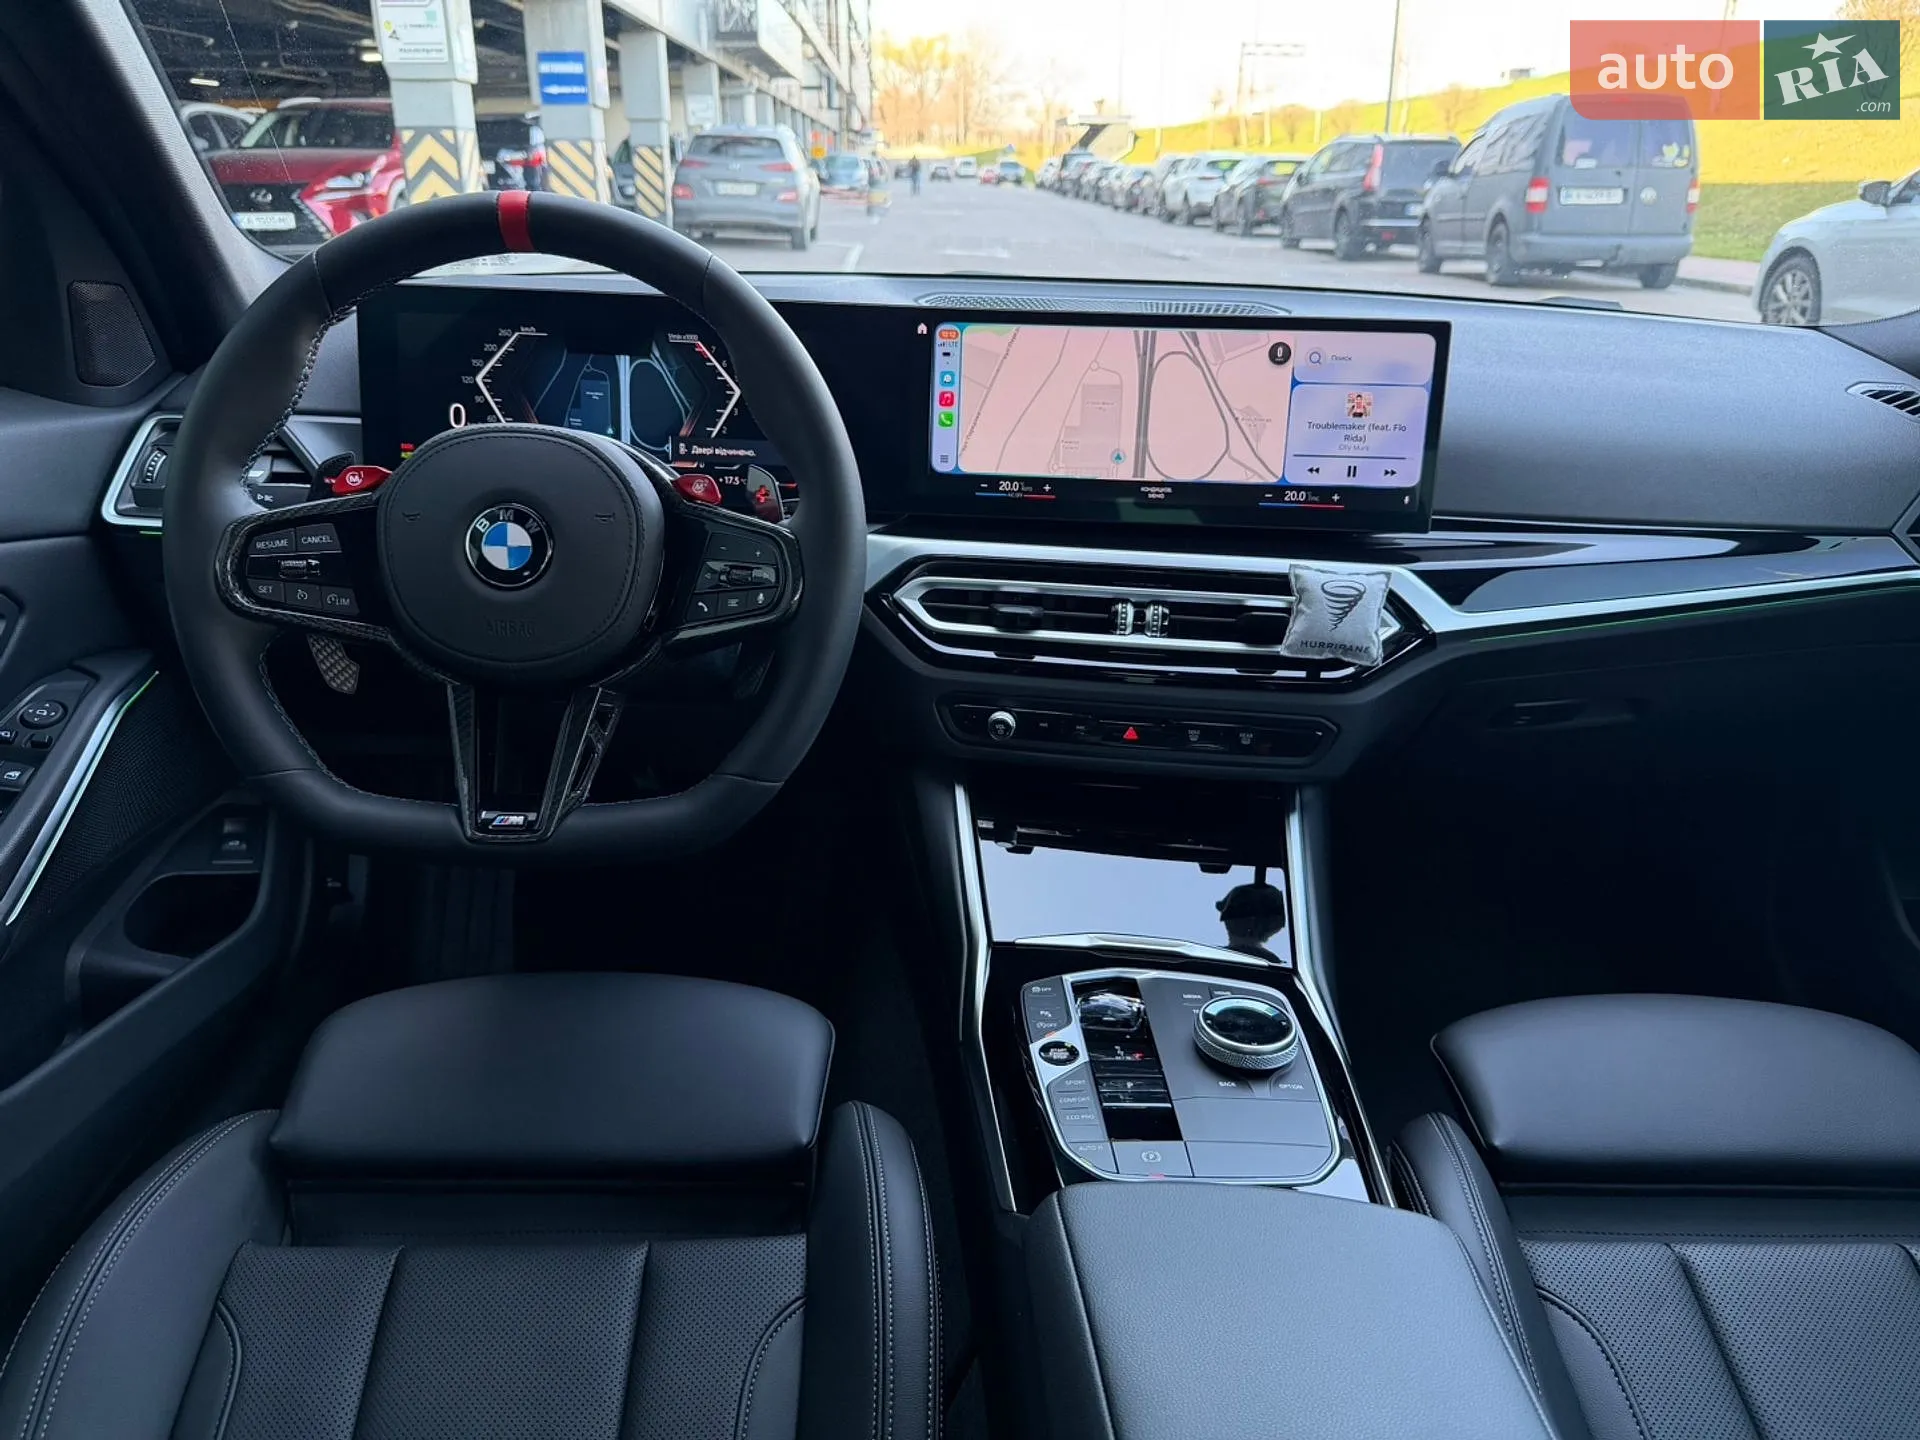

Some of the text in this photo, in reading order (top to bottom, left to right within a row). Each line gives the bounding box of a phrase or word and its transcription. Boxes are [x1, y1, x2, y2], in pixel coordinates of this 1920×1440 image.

[461, 375, 475, 383] 120
[449, 403, 466, 428] 0
[1307, 421, 1407, 432] Troublemaker (feat. Flo
[1343, 434, 1367, 442] Rida)
[999, 481, 1019, 491] 20.0
[1284, 491, 1306, 501] 20.0
[475, 508, 541, 534] BMW
[256, 538, 289, 549] RESUME
[301, 535, 333, 544] CANCEL
[336, 598, 350, 606] LIM
